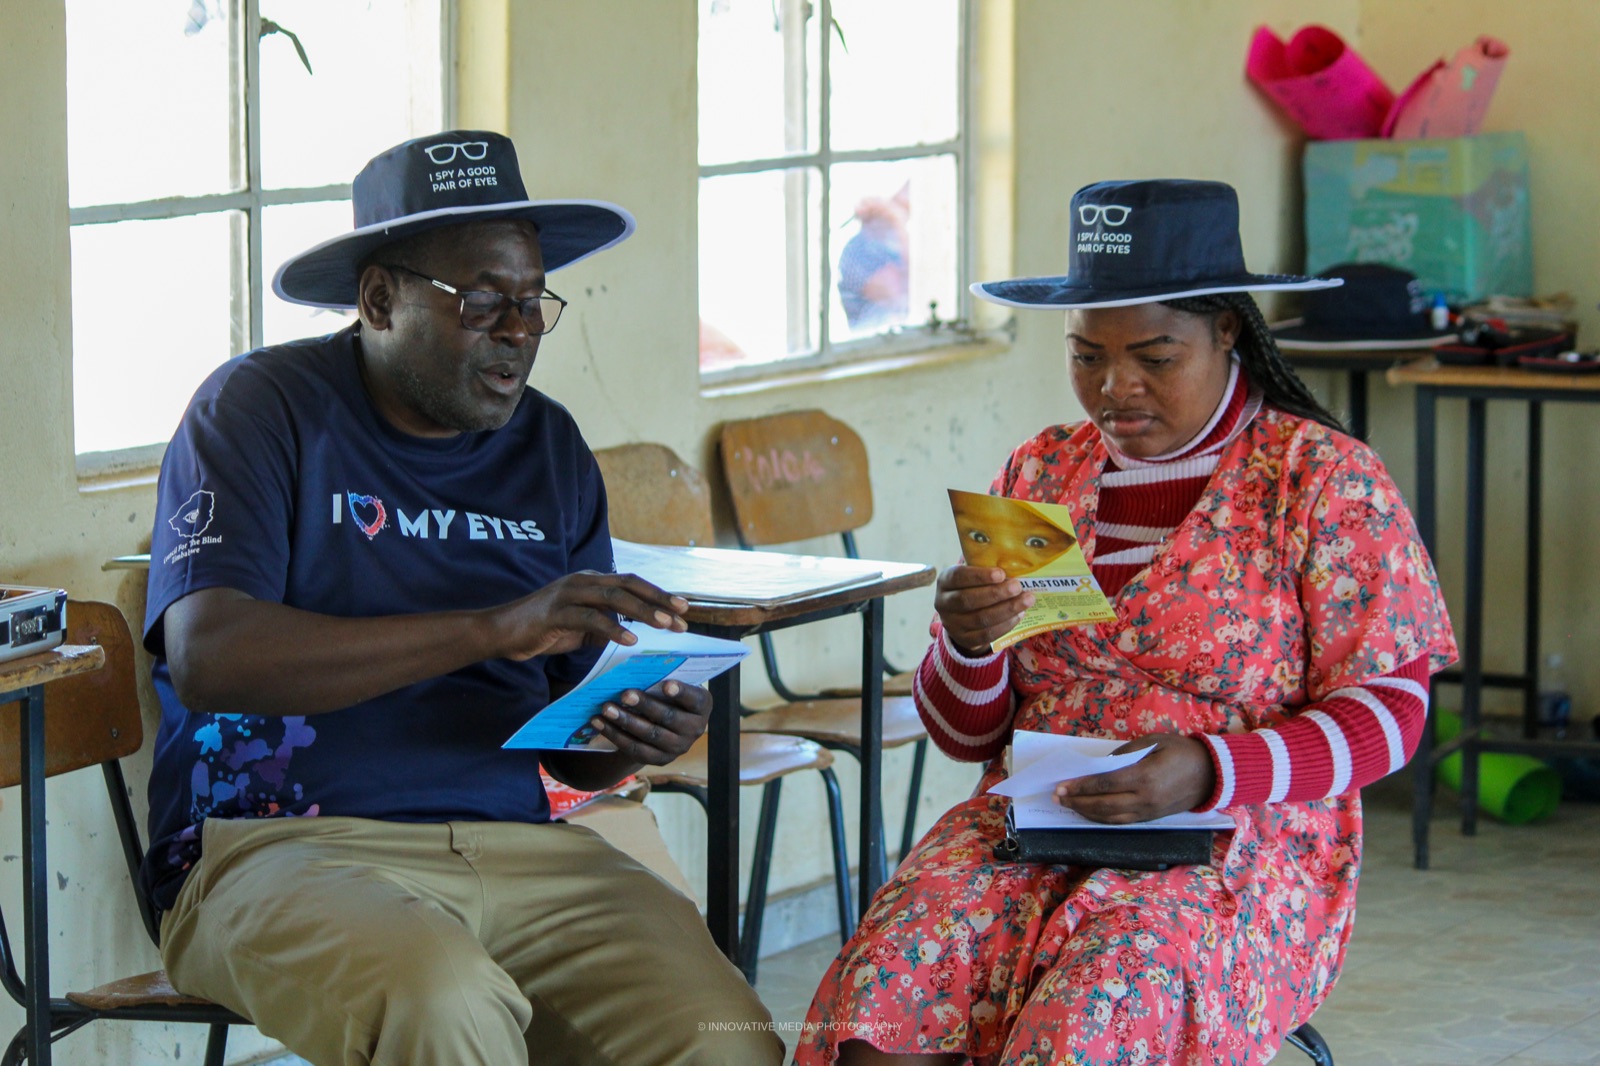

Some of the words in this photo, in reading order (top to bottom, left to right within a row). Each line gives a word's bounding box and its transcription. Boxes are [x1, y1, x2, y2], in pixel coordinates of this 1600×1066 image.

[429, 173, 433, 182] I
[435, 169, 455, 181] SPY
[457, 168, 466, 178] A
[467, 166, 496, 176] GOOD
[432, 180, 456, 193] PAIR
[458, 179, 472, 188] OF
[474, 177, 498, 187] EYES
[1081, 232, 1094, 242] SPY
[1094, 232, 1100, 242] A
[1101, 232, 1132, 243] GOOD
[1077, 243, 1092, 254] PAIR
[1092, 243, 1105, 253] OF
[1105, 244, 1131, 254] EYES
[332, 493, 342, 524] I
[396, 508, 456, 540] MY
[465, 511, 546, 542] EYES
[202, 535, 222, 544] Blind
